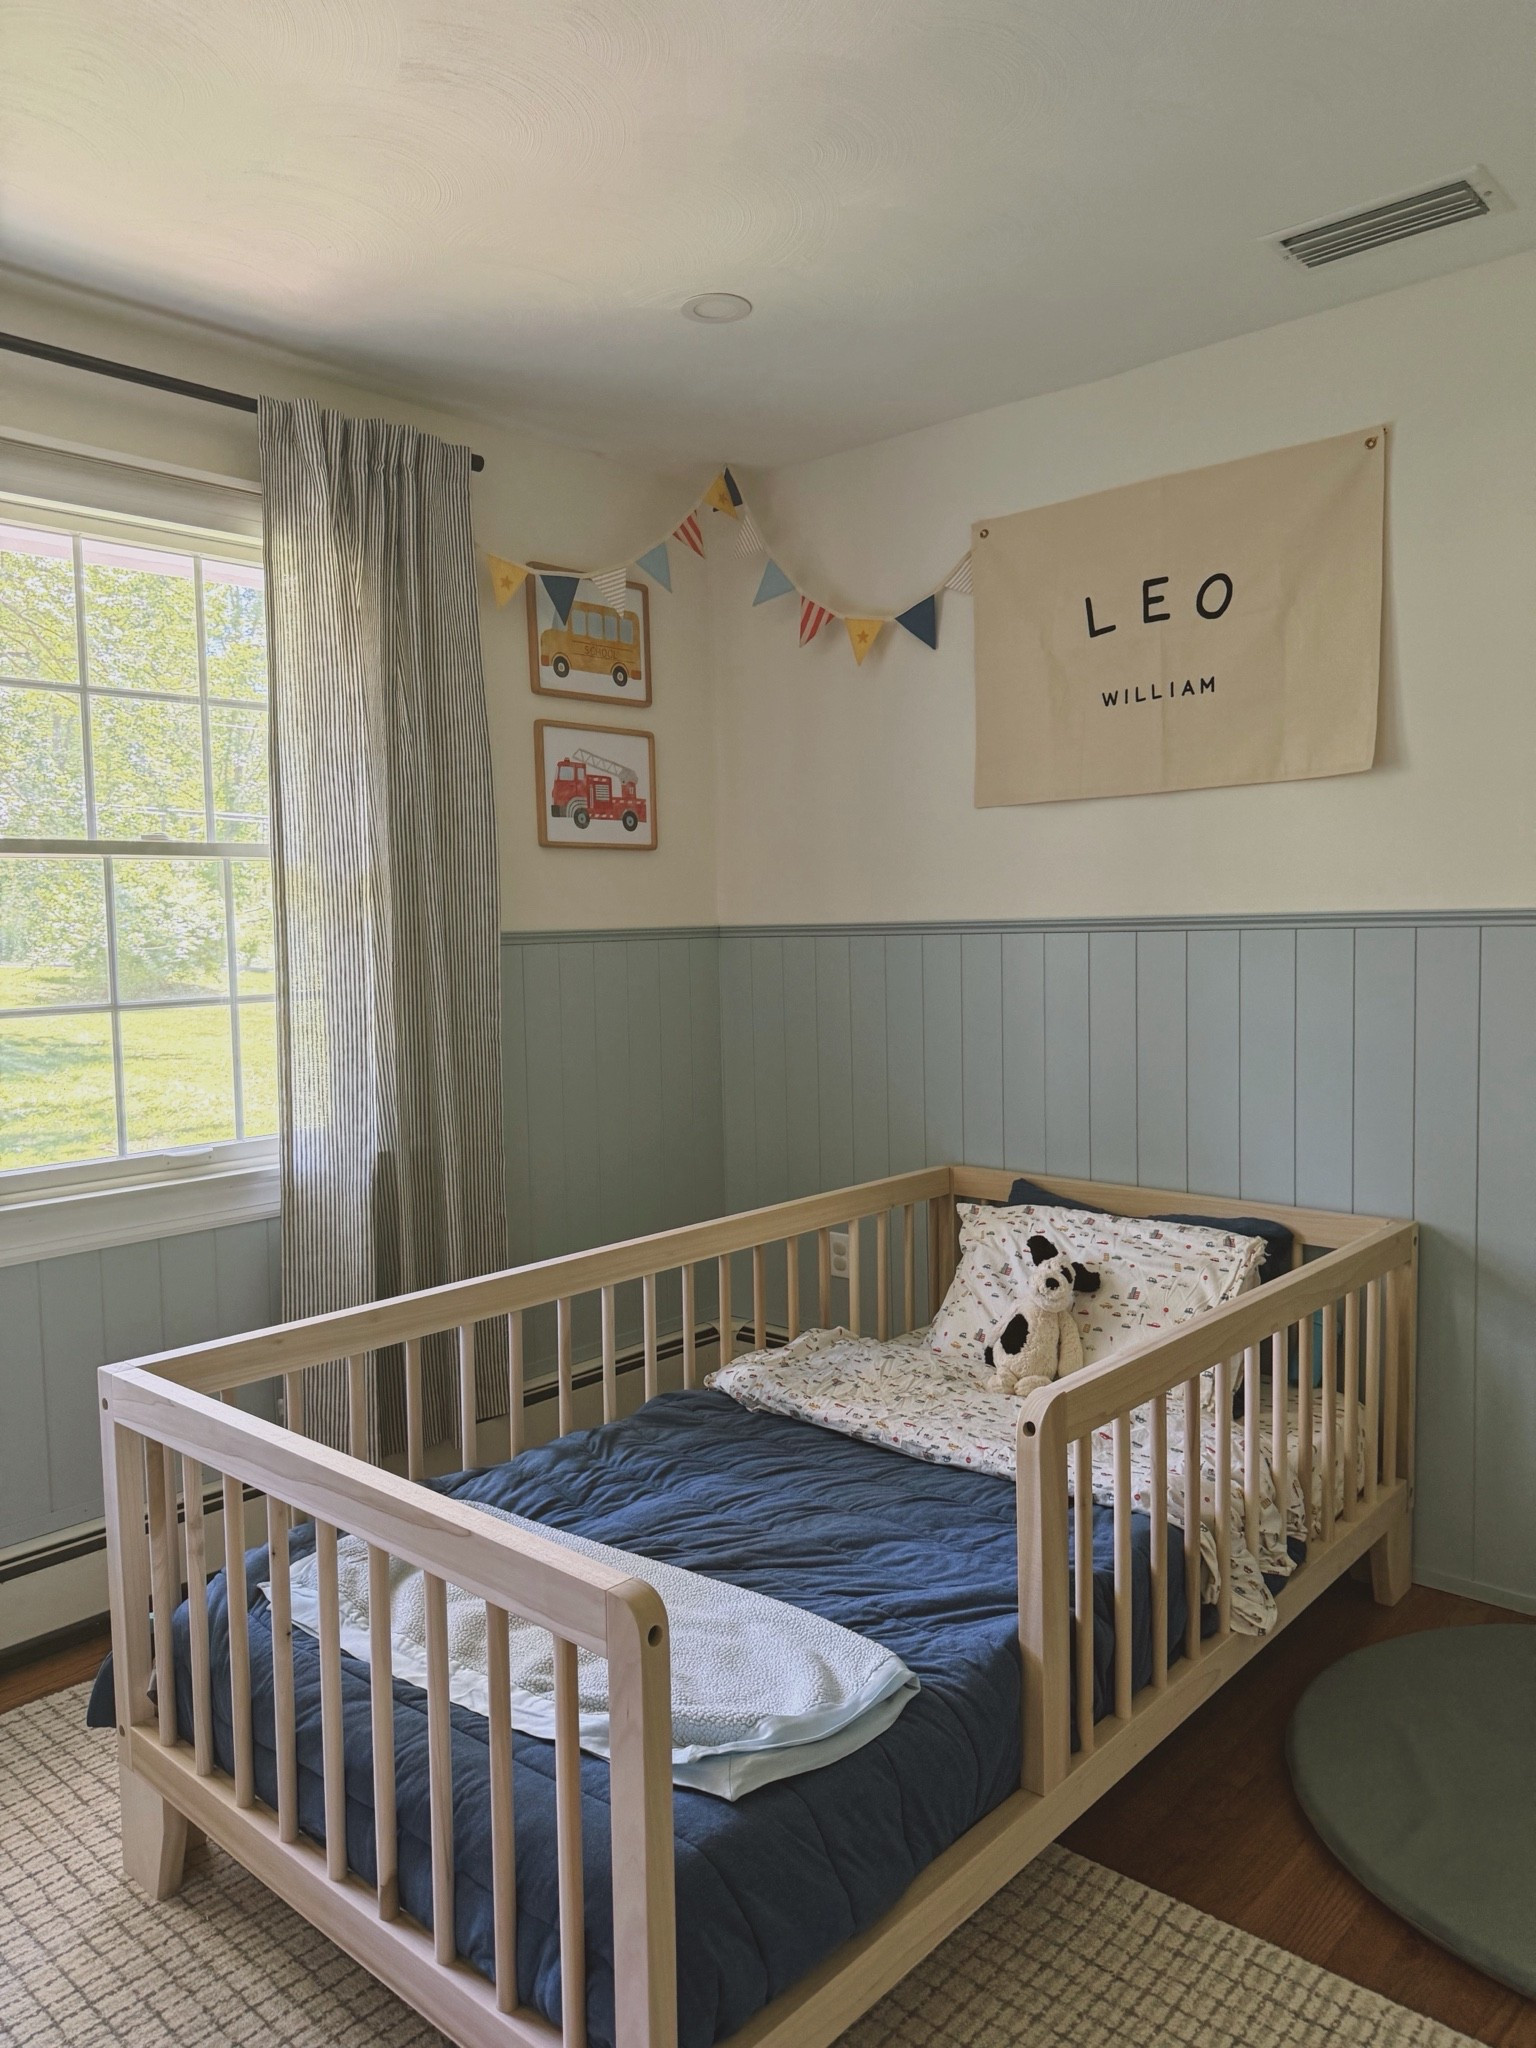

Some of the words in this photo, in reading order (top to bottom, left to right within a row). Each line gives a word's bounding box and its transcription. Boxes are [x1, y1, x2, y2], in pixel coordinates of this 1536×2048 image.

[1085, 572, 1233, 638] LEO
[584, 645, 618, 660] SCHOOL
[1102, 676, 1215, 707] WILLIAM
